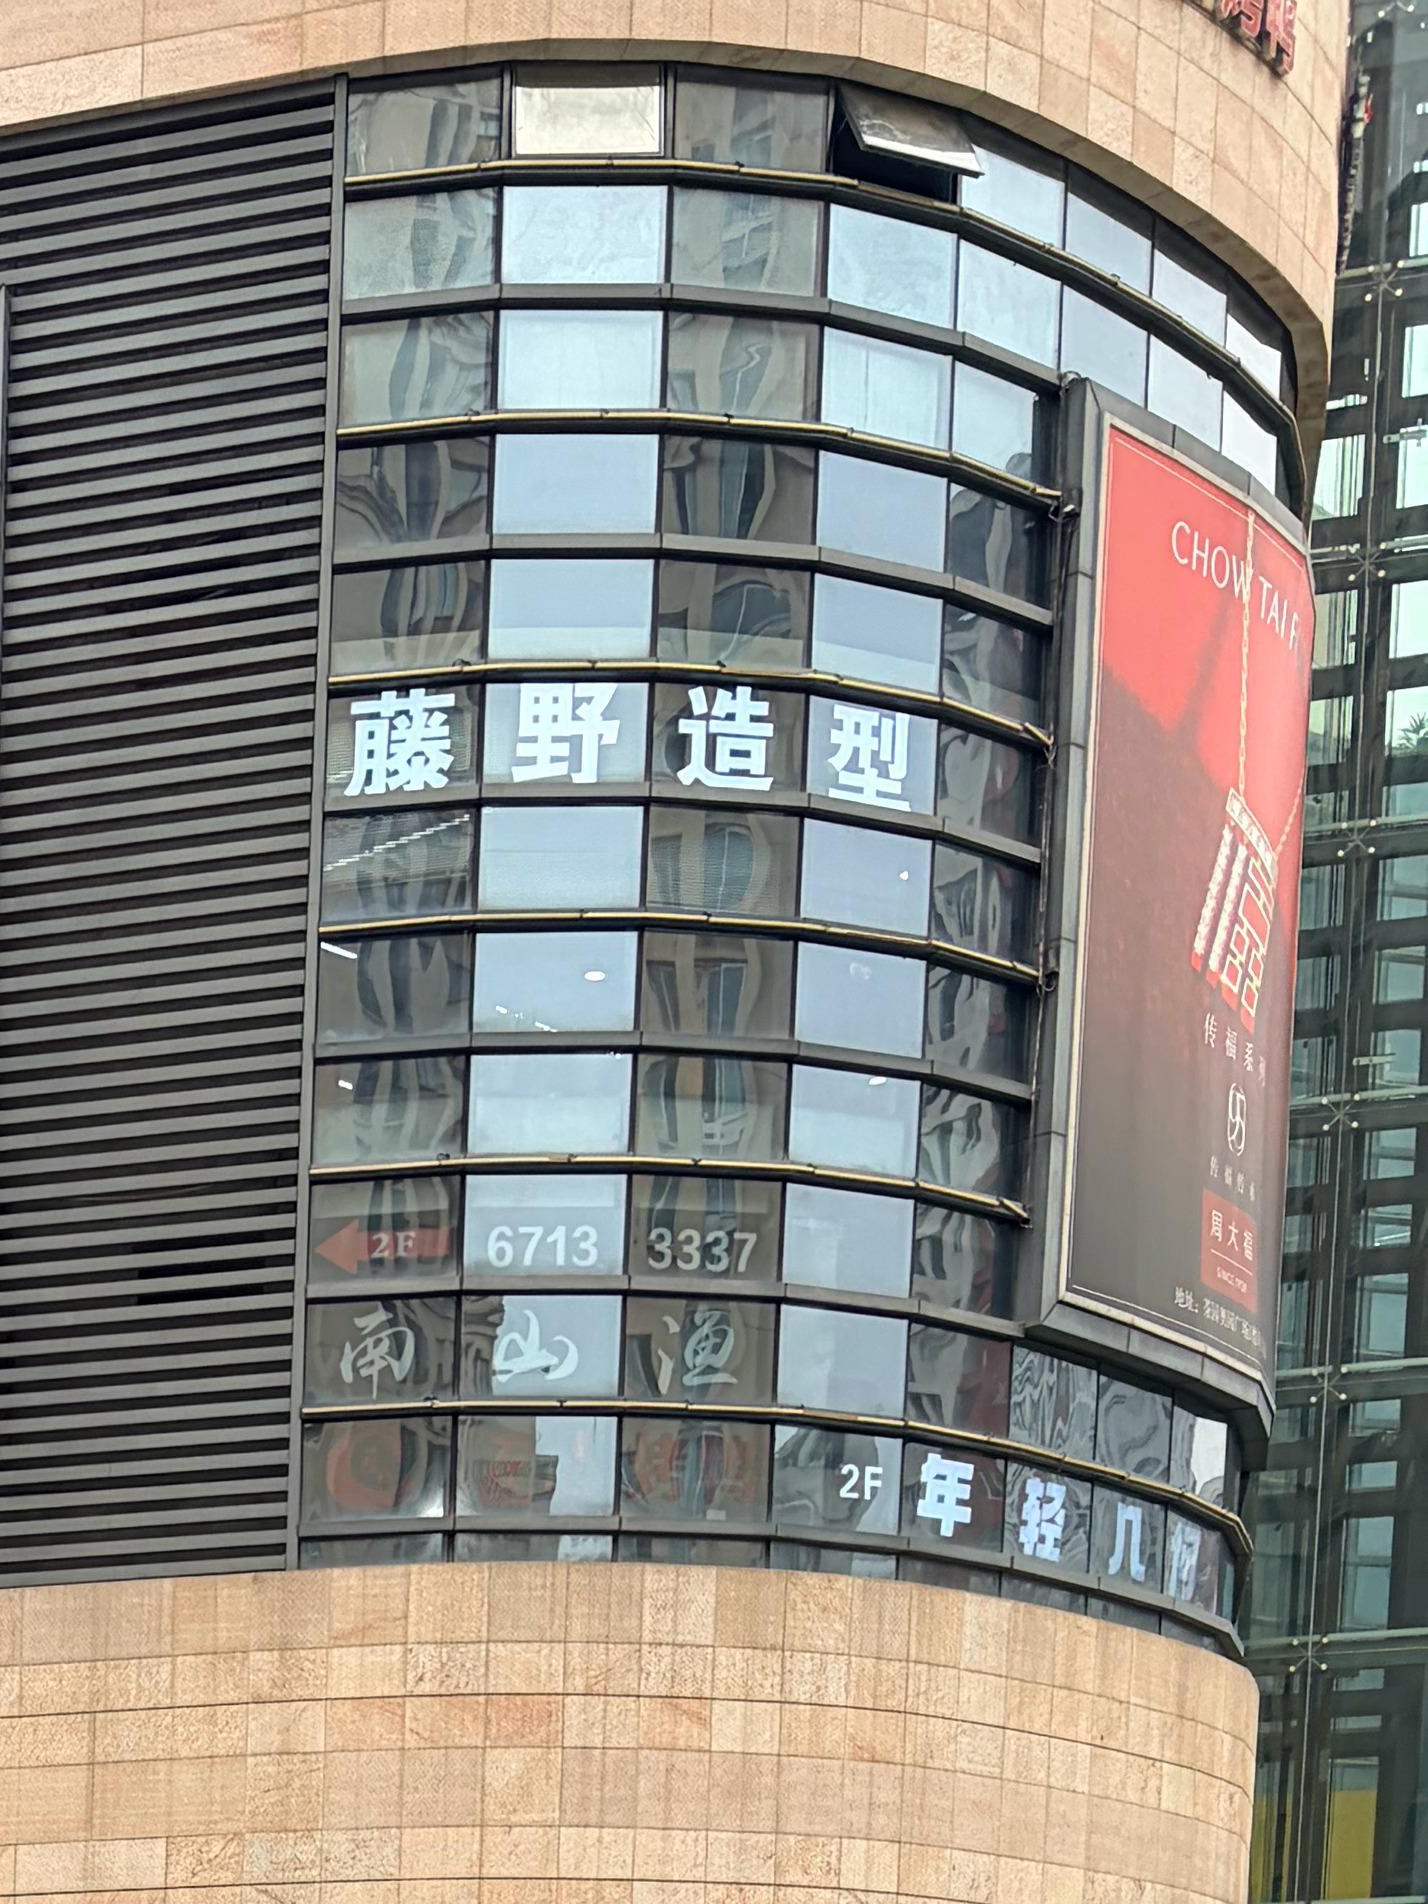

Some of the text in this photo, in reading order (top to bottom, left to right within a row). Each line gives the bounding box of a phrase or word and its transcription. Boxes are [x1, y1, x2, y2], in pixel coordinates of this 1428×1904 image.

[1172, 521, 1254, 604] CHOW
[1259, 575, 1288, 639] TAI
[345, 682, 911, 812] 藤野造型
[371, 1231, 416, 1259] 2F
[487, 1224, 758, 1274] 6713 3337
[1210, 1209, 1254, 1262] 周大福
[839, 1463, 884, 1501] 2F
